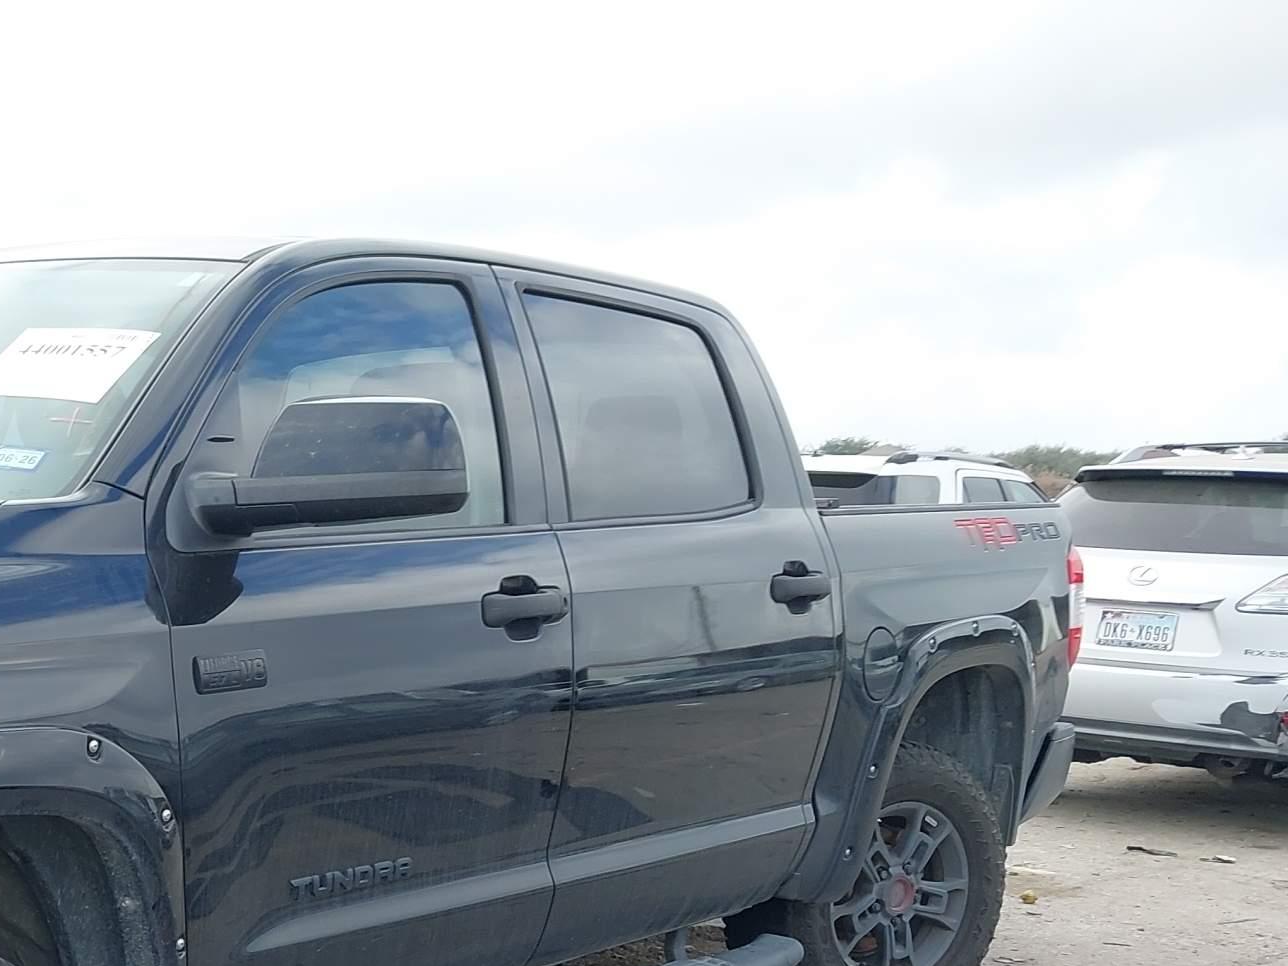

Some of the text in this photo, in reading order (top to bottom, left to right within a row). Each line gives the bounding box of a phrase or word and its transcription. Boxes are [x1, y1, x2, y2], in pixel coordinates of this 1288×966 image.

[953, 517, 1061, 552] TRD PRO
[289, 857, 413, 900] TUNDRA
